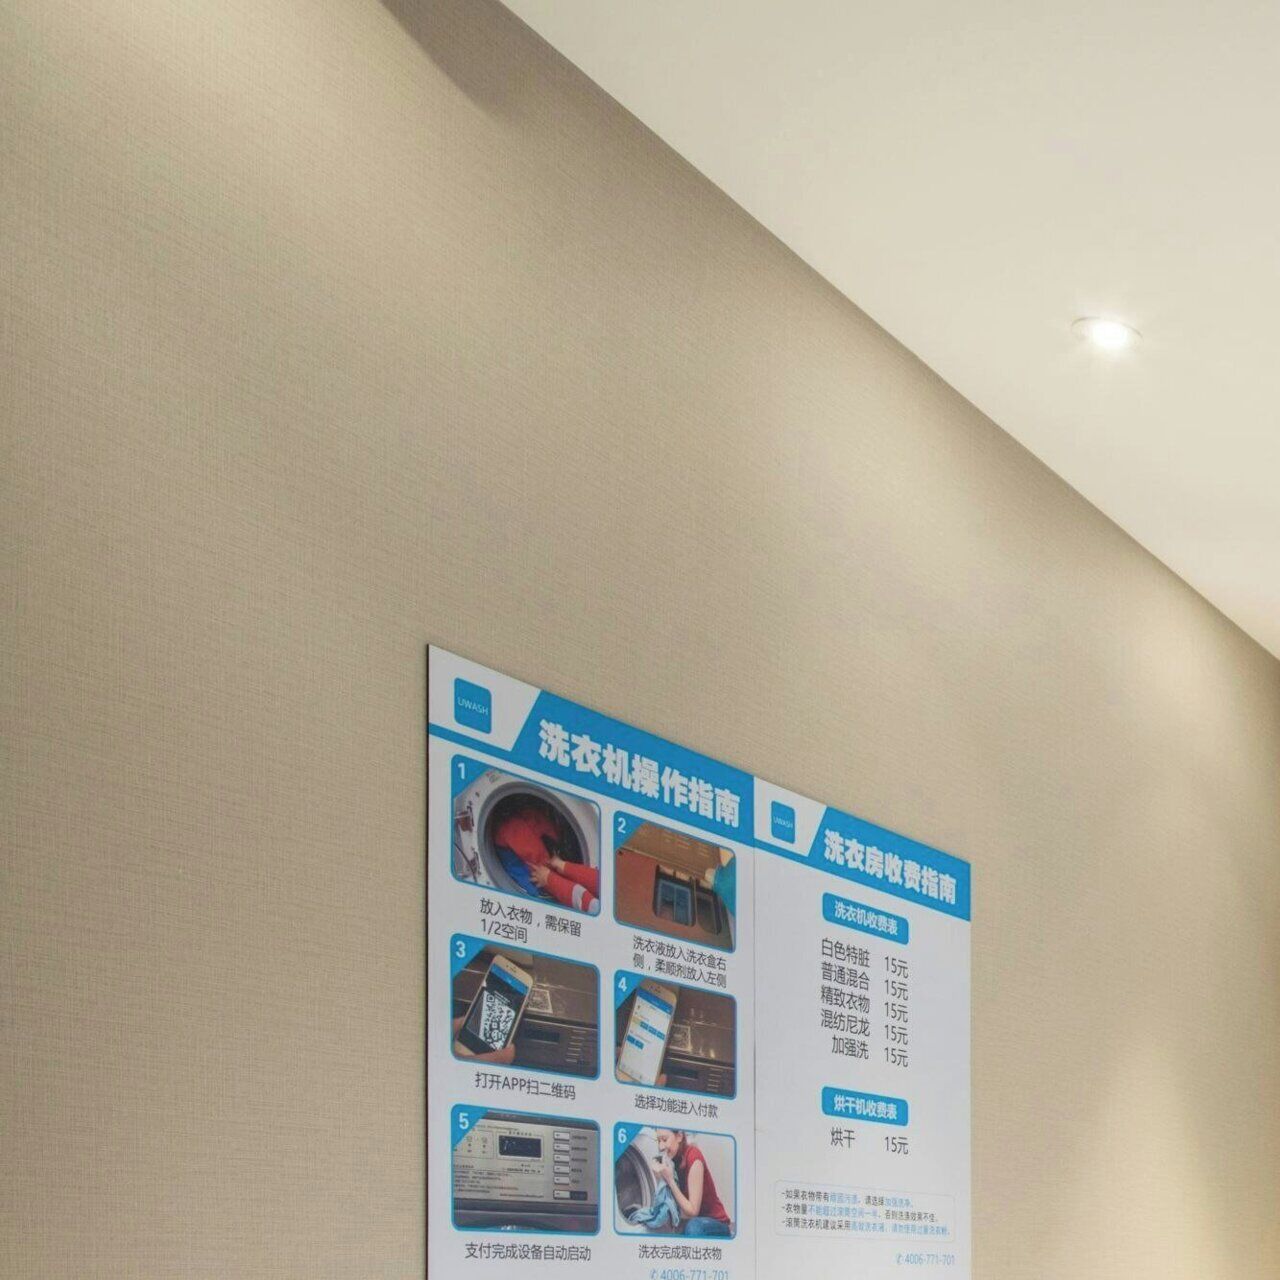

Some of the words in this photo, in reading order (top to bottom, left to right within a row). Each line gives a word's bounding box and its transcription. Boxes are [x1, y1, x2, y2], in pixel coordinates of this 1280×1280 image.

[457, 698, 489, 716] UWASH
[457, 762, 466, 780] 1
[538, 718, 741, 829] 洗衣机操作指南
[617, 817, 627, 834] 2
[823, 828, 957, 905] 洗衣房收费指南
[480, 918, 528, 944] 1/2空间
[834, 900, 899, 936] 洗衣机收费表
[455, 941, 466, 958] 3
[633, 934, 727, 972] 洗衣液放入洗衣盒右
[821, 937, 870, 968] 白色特脏
[884, 956, 909, 979] 15元
[618, 977, 628, 993] 4
[821, 962, 870, 991] 普通混合
[884, 979, 909, 1001] 15元
[821, 985, 870, 1014] 精致衣物
[884, 1002, 909, 1023] 15元
[821, 1008, 870, 1038] 混纺尼龙
[884, 1024, 909, 1046] 15元
[832, 1036, 869, 1060] 加强洗
[884, 1047, 909, 1068] 15元
[475, 1071, 576, 1100] 打开APP扫二维码
[634, 1094, 719, 1119] 选择功能进入付款
[833, 1094, 898, 1121] 烘干机收费表
[459, 1112, 469, 1130] 5
[617, 1128, 627, 1144] 6
[830, 1127, 856, 1149] 烘干
[884, 1136, 909, 1155] 15元
[464, 1242, 592, 1262] 支付完成设备自动启动
[638, 1243, 722, 1261] 洗衣完成取出衣物
[904, 1253, 956, 1267] 4006-771-701
